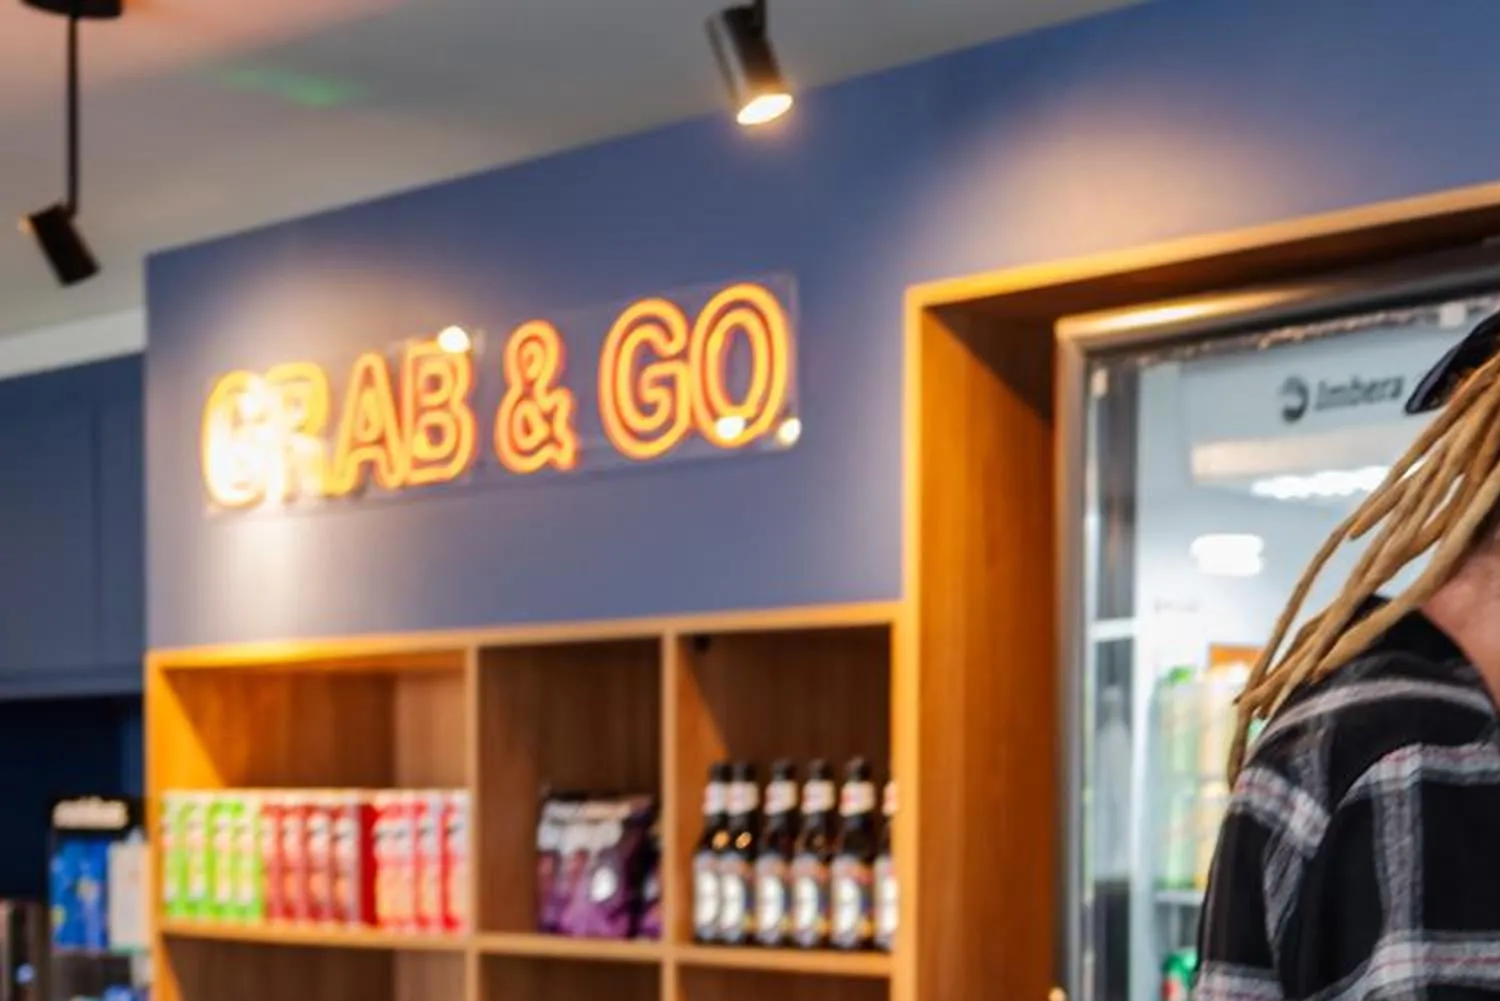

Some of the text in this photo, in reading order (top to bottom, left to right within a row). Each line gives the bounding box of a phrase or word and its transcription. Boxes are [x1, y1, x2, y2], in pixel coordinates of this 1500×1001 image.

[203, 281, 790, 508] GRAB & GO
